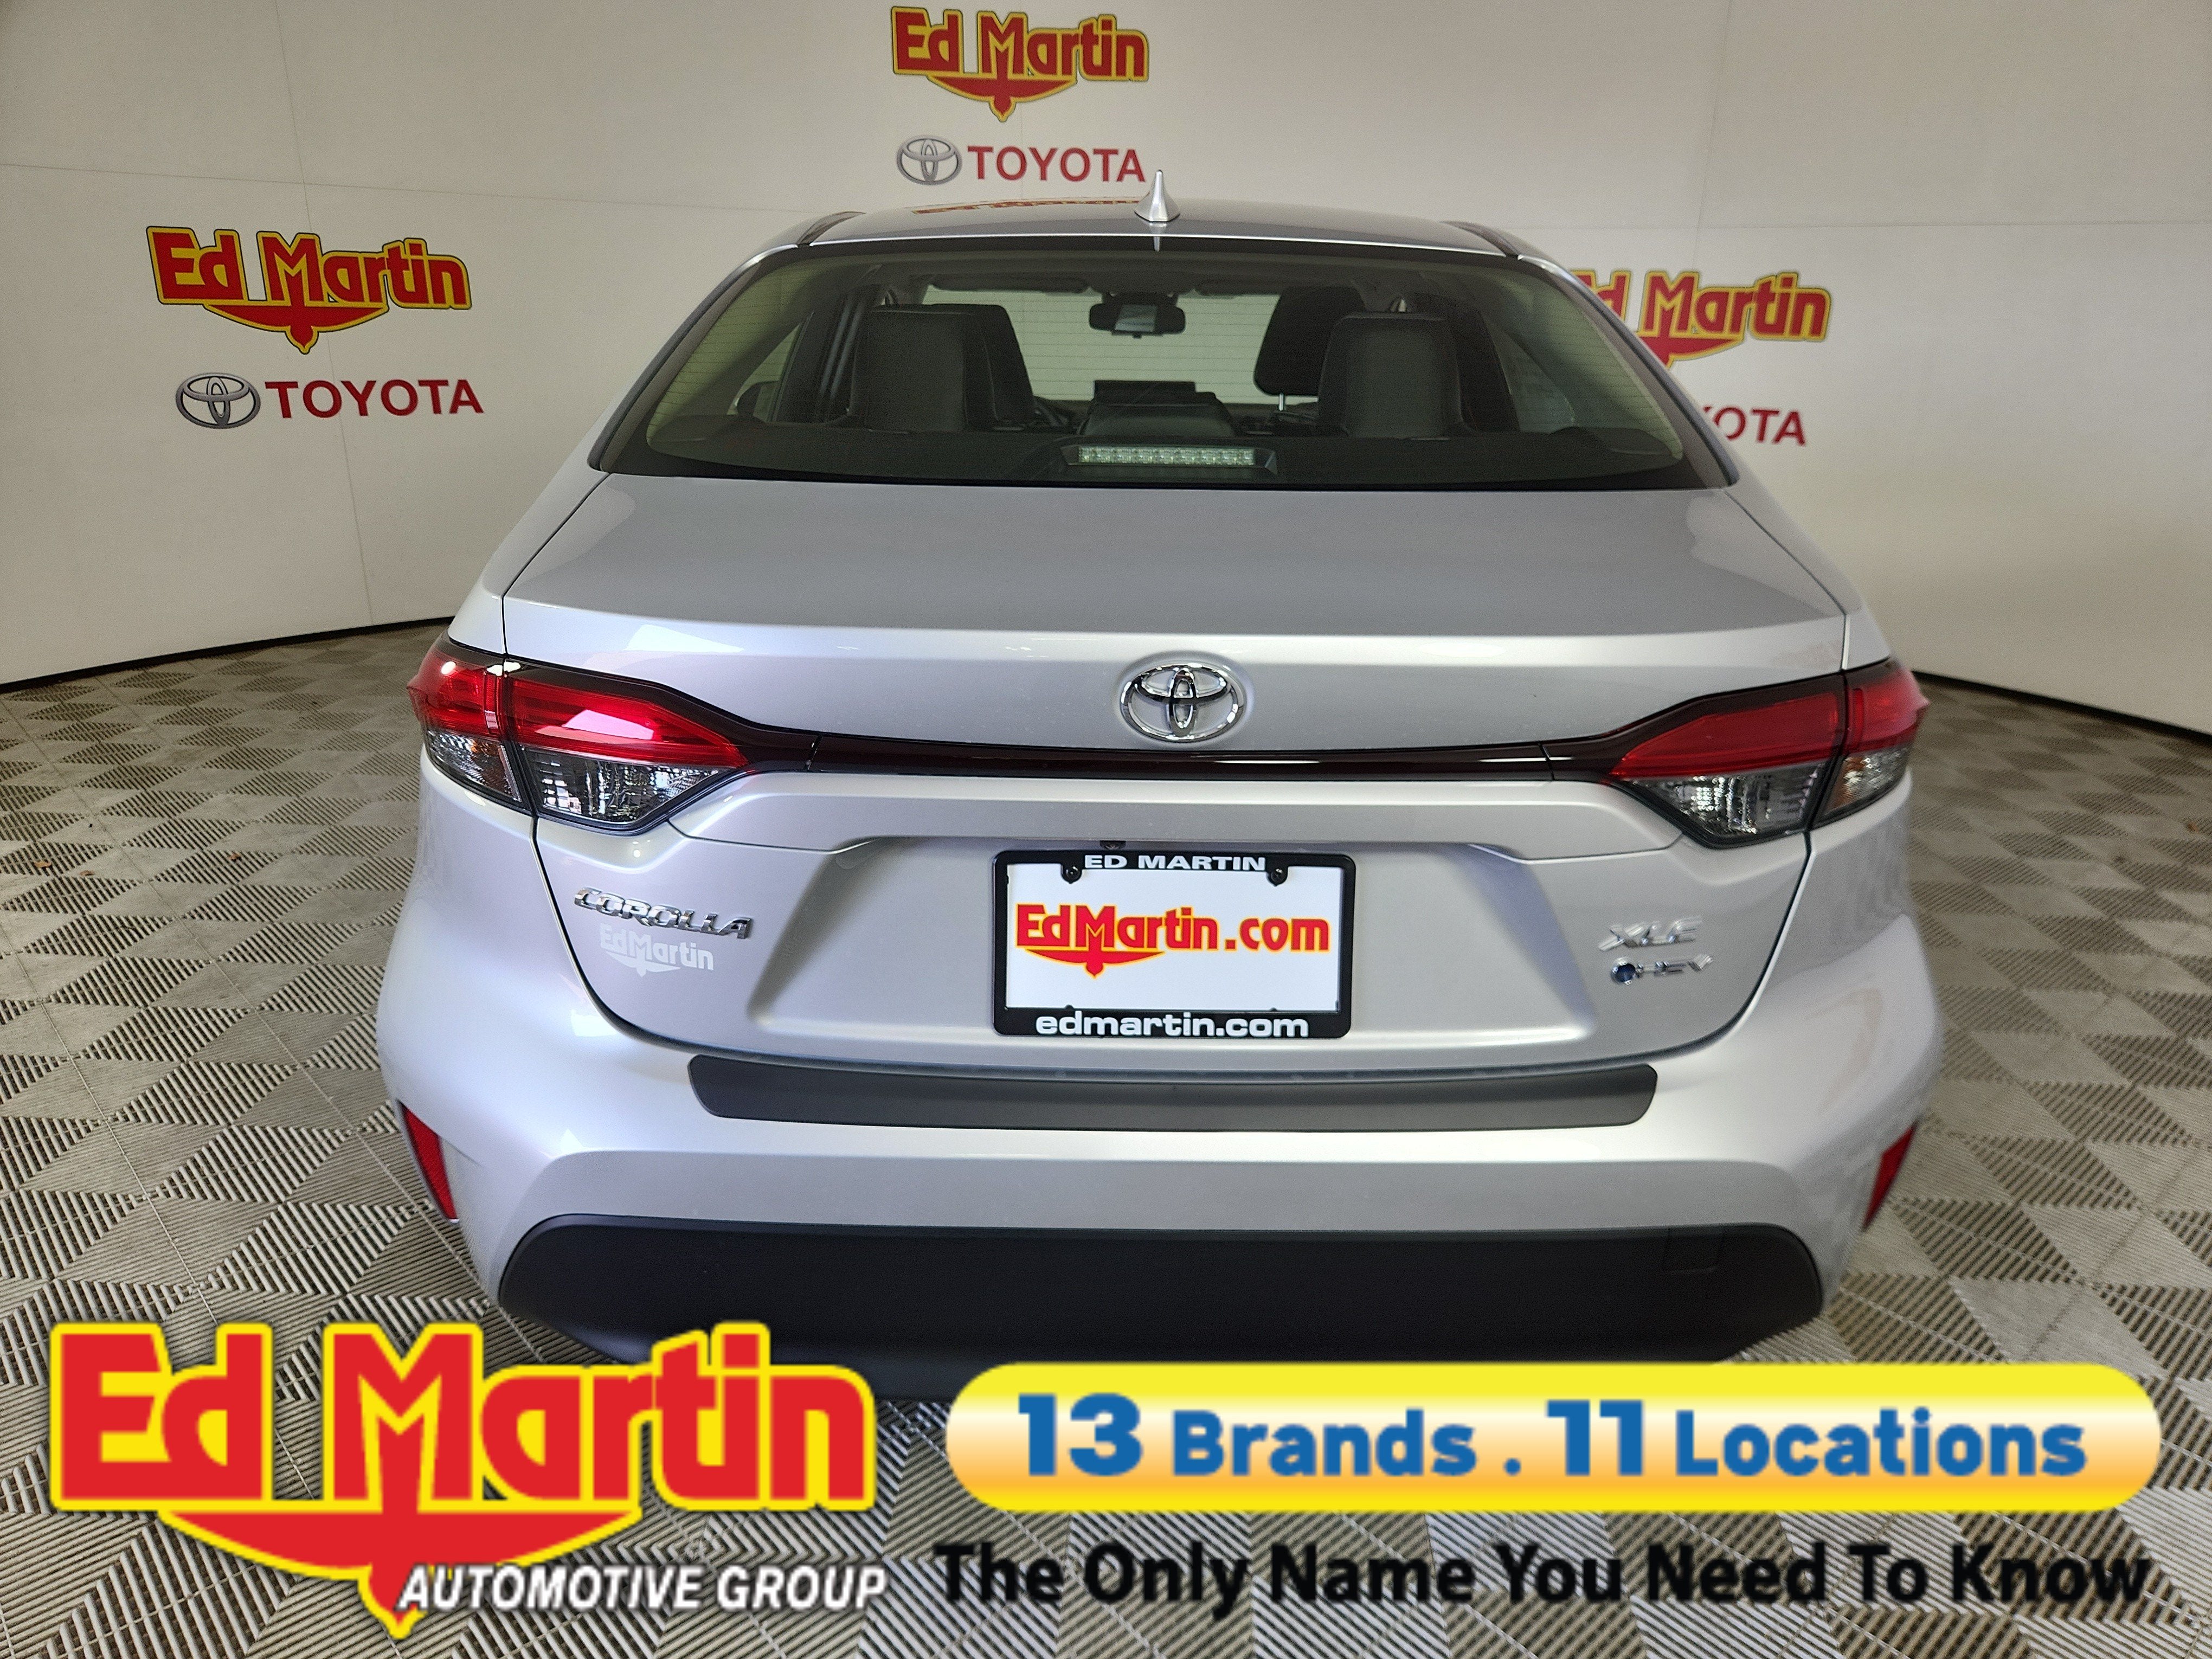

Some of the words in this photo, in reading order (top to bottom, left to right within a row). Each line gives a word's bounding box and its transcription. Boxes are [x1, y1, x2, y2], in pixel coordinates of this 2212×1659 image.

[891, 7, 963, 75] Ed
[978, 11, 1149, 81] Martin
[967, 146, 1146, 183] TOYOTA
[146, 226, 248, 304] Ed
[256, 231, 472, 310] Martin
[1638, 270, 1831, 342] Martin
[265, 380, 484, 419] TOYOTA
[1084, 855, 1127, 870] ED
[1138, 856, 1266, 871] MARTIN
[574, 886, 754, 939] COROLLA
[1598, 916, 1703, 951] XLE
[1035, 1010, 1309, 1038] edmartin.com
